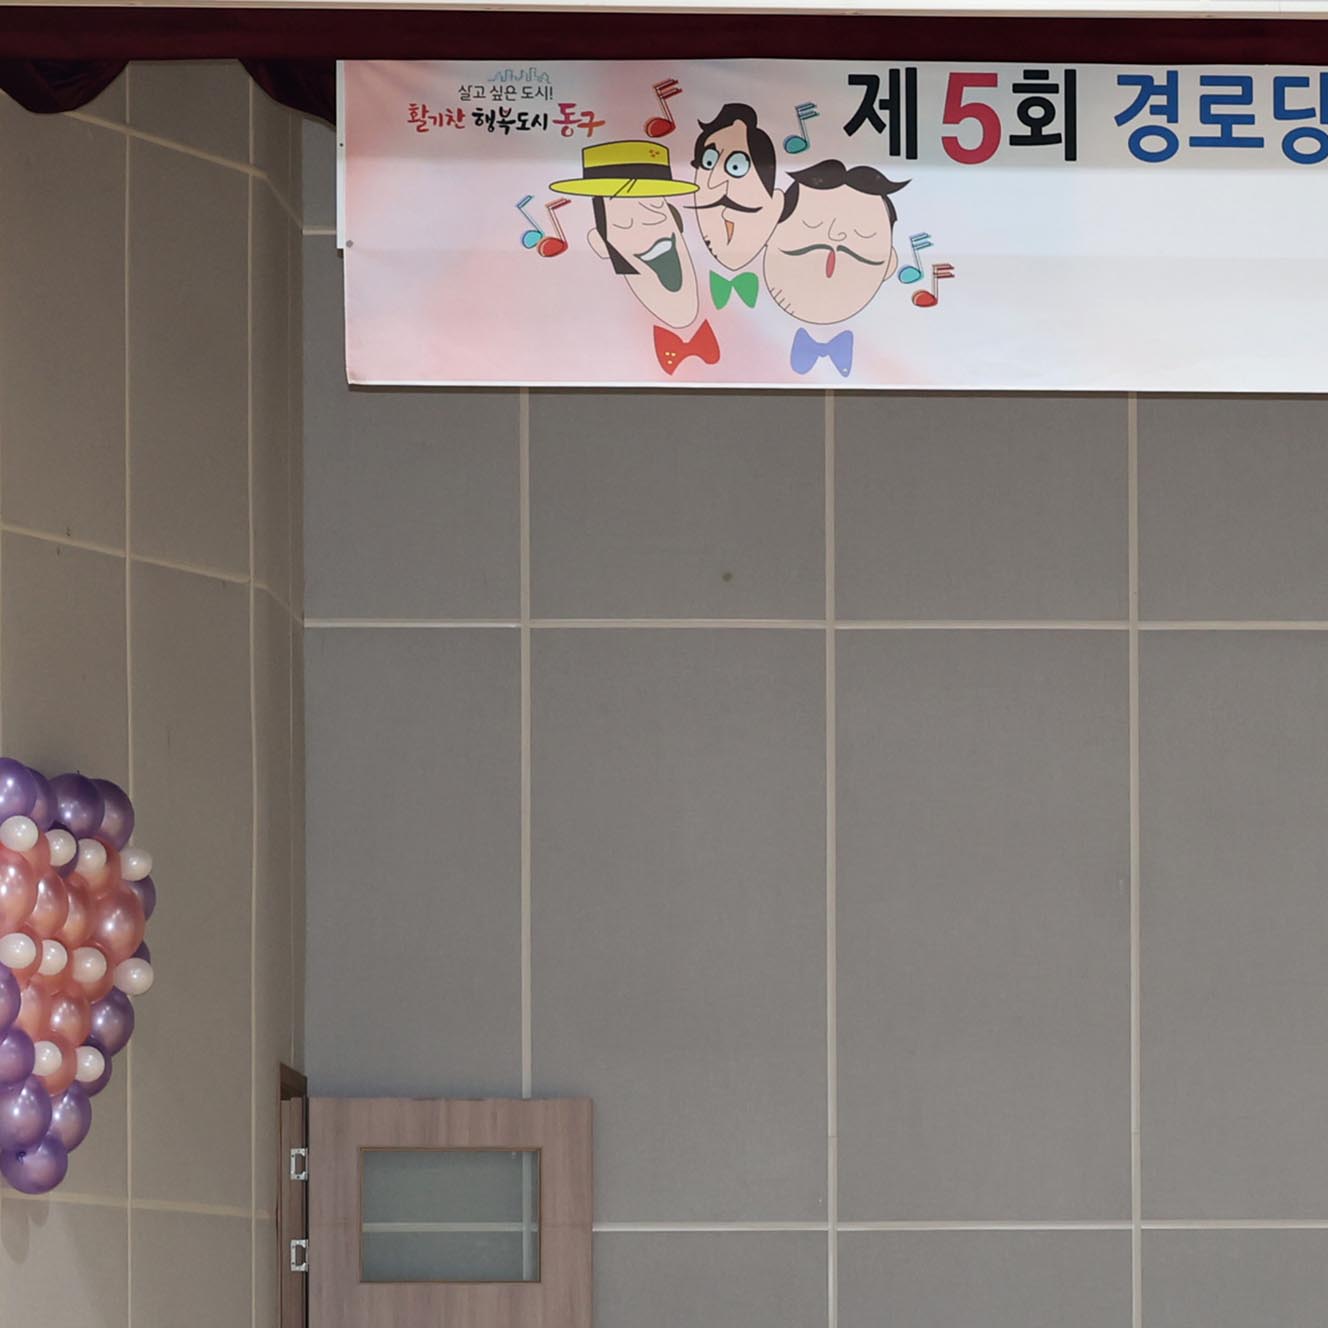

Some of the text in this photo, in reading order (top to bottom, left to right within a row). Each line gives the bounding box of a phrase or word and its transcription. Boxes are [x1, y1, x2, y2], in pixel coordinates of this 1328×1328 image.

[458, 84, 553, 101] 살고 싶은 도시!
[407, 102, 606, 138] 활기찬 행복도시 동구
[841, 67, 1078, 165] 제5회
